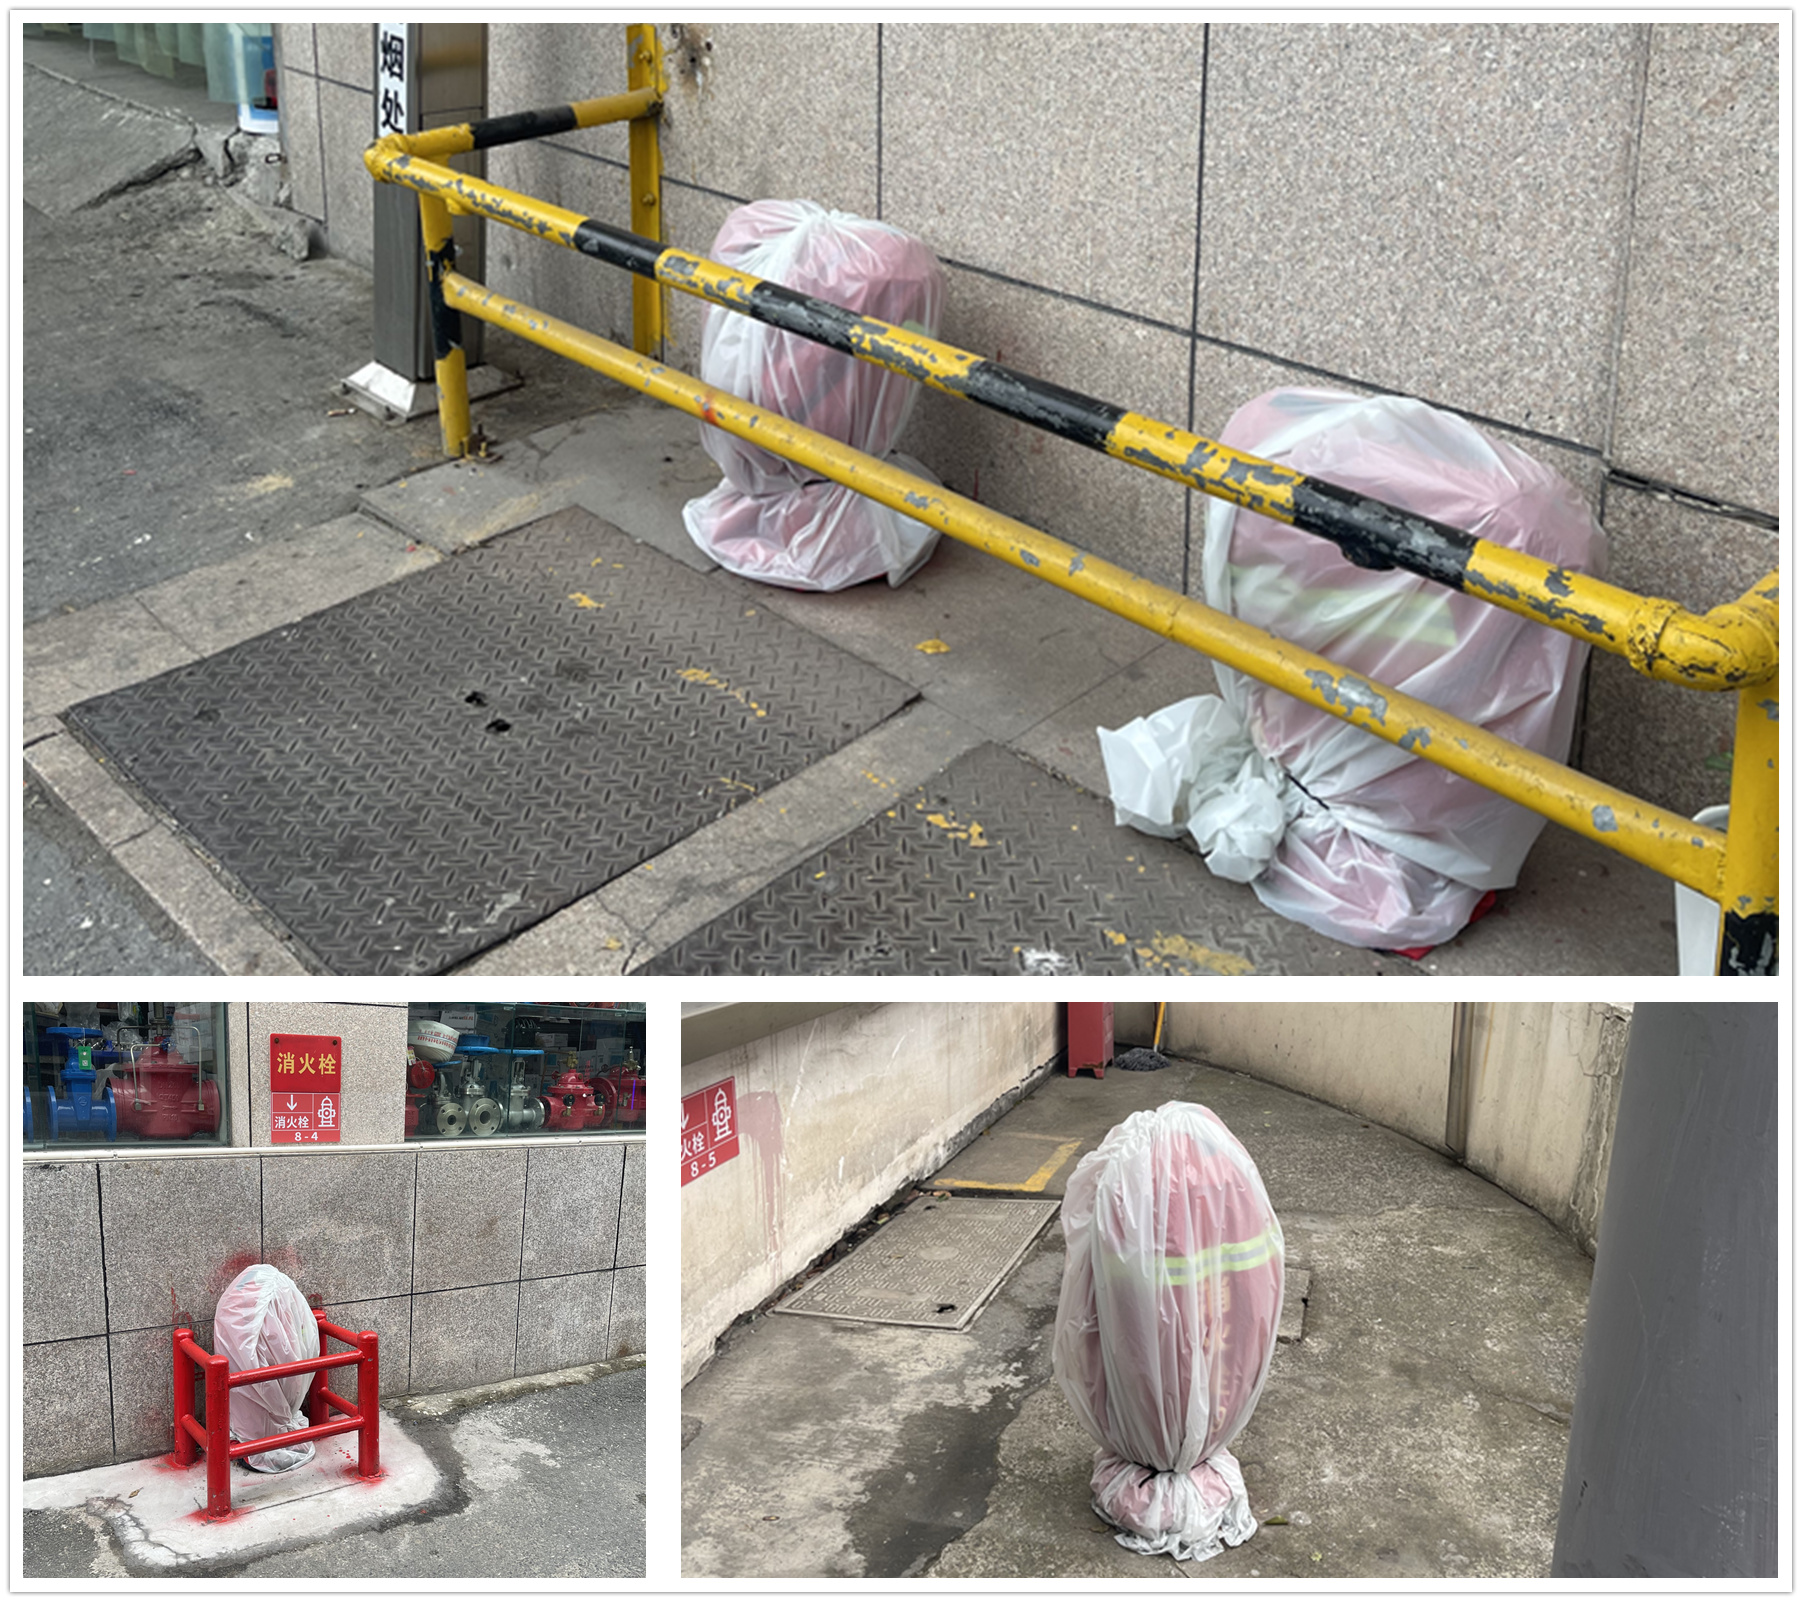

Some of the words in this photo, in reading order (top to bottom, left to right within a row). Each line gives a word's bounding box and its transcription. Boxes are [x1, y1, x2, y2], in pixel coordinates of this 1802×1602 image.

[277, 1052, 336, 1075] 消火栓
[274, 1116, 309, 1129] 消火栓
